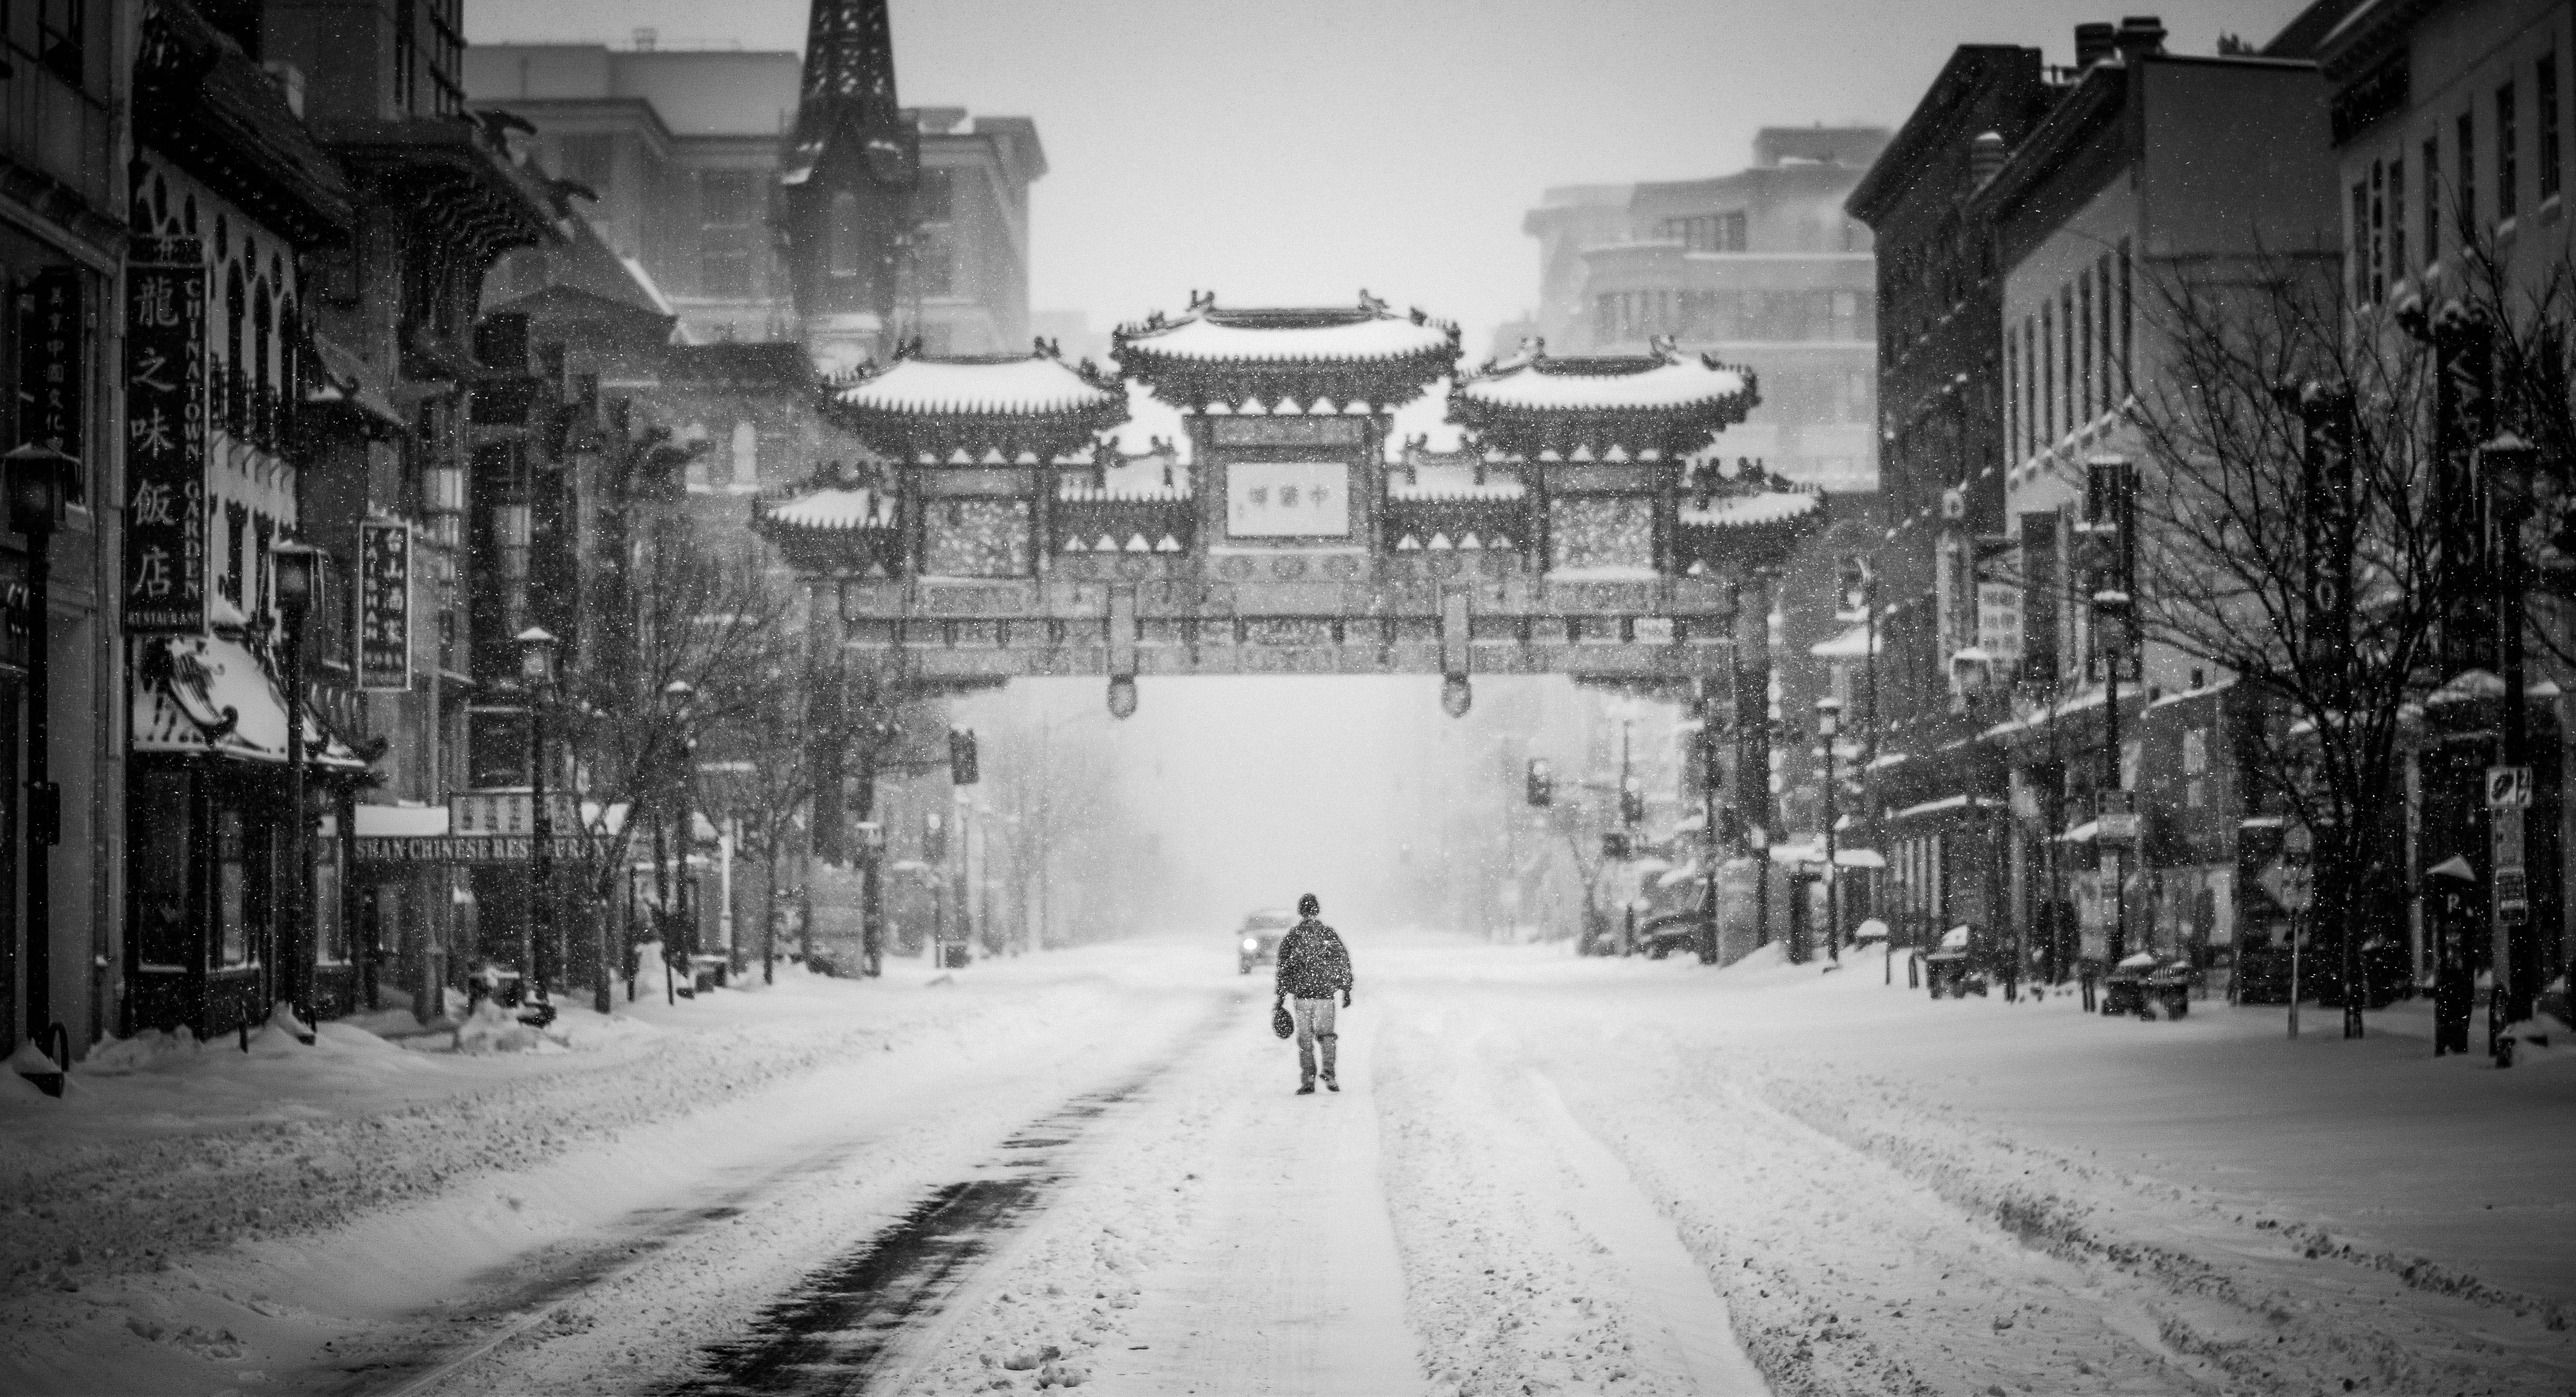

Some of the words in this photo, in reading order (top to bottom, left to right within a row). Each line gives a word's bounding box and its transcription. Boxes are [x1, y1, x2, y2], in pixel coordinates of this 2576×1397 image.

[130, 276, 180, 597] 龍之味飯店
[184, 278, 202, 461] CHINATOWN
[184, 480, 201, 599] GARDEN
[409, 838, 489, 860] CHINESE
